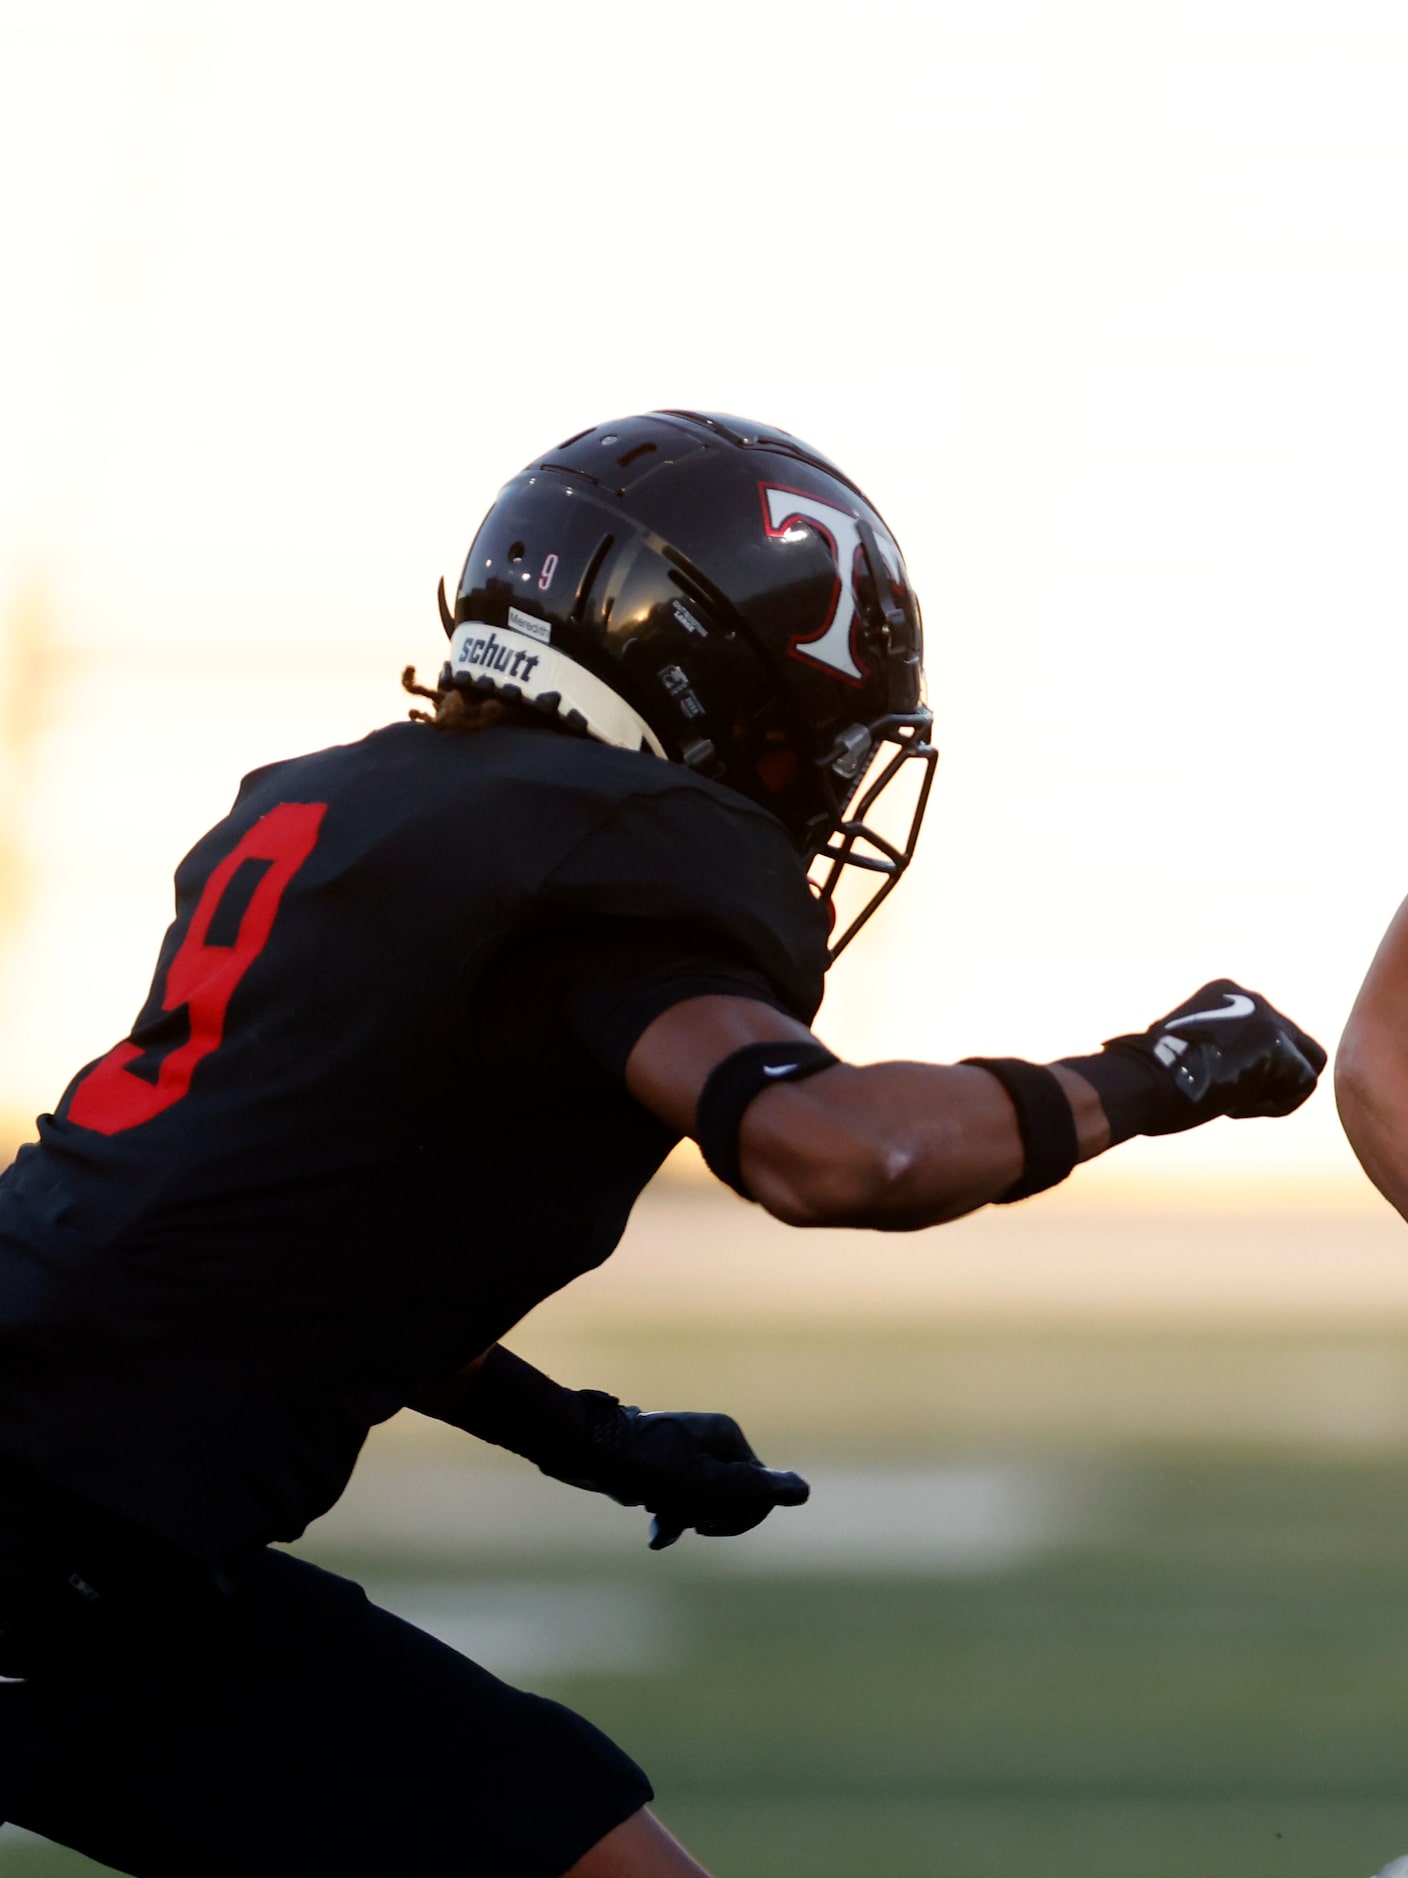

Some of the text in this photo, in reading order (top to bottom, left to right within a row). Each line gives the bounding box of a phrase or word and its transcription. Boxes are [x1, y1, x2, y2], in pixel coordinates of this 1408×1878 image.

[538, 553, 559, 592] 9
[757, 481, 907, 689] T
[458, 633, 539, 682] schutt
[67, 802, 328, 1136] 9
